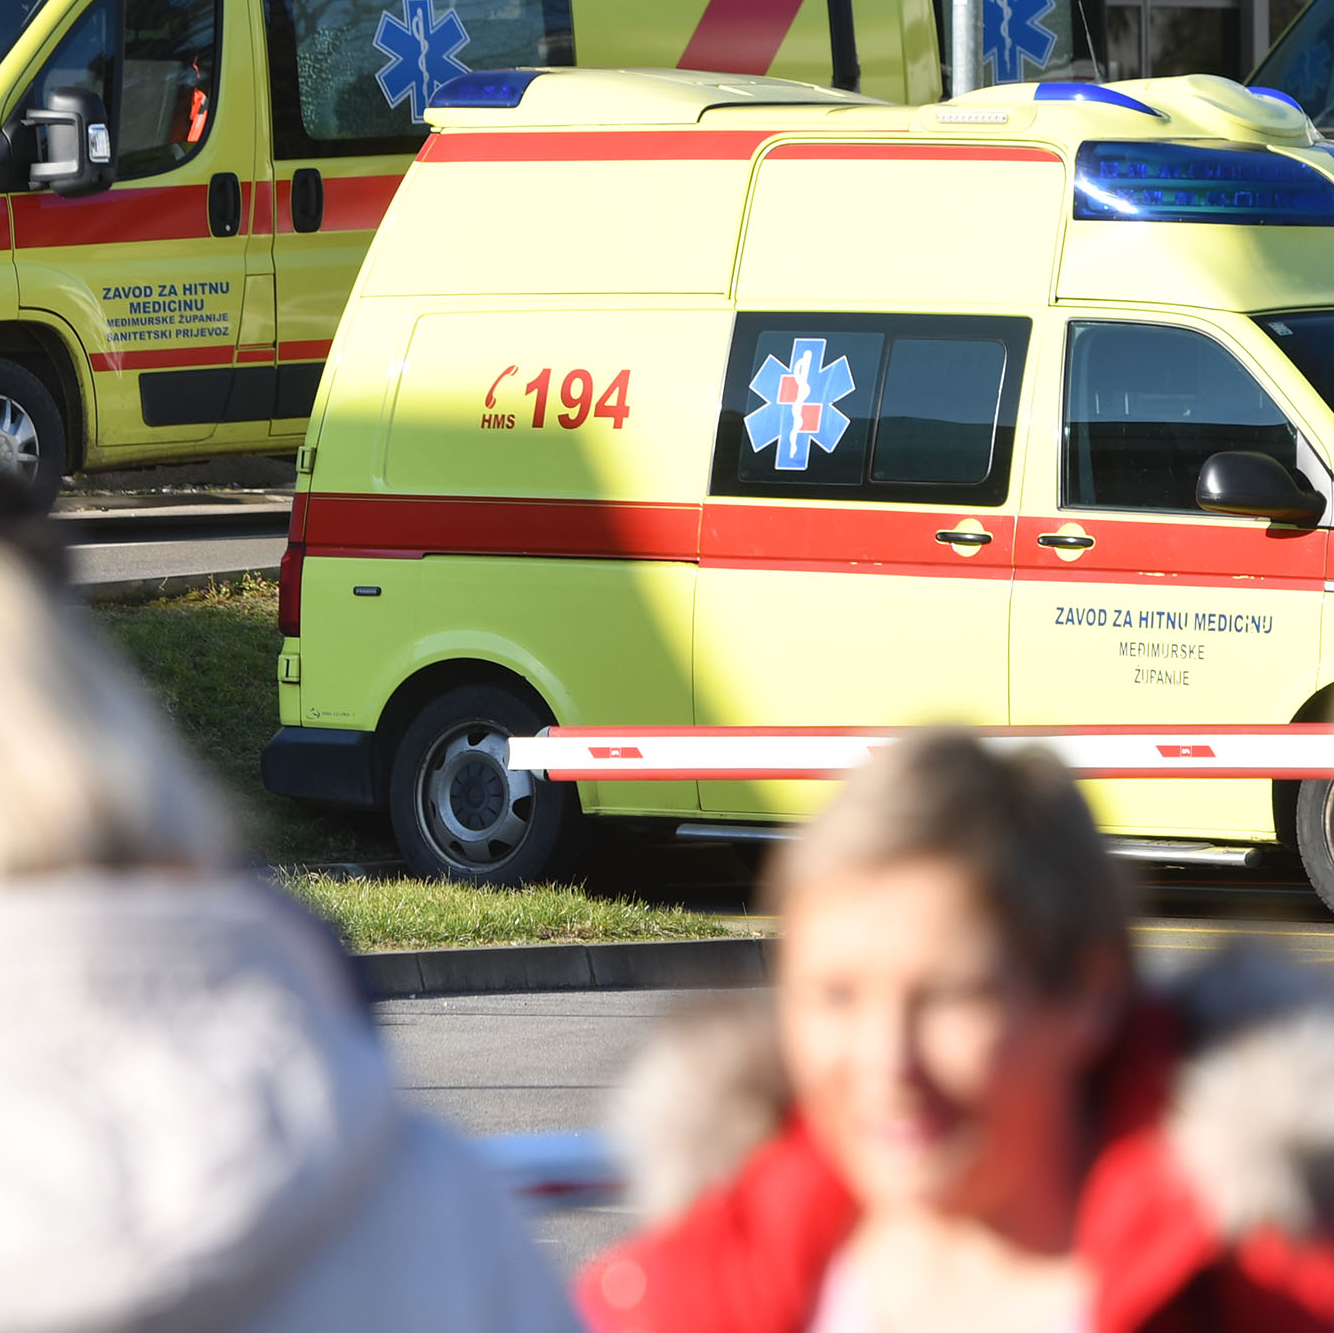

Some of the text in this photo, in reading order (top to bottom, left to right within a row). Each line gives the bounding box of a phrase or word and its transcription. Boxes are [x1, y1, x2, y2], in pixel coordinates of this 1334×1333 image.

[102, 282, 230, 300] ZAVOD ZA HITNU
[129, 299, 205, 314] MEDICINU
[179, 312, 229, 324] ŽUPANIJE
[107, 327, 229, 342] SANITETSKI PRIJEVOZ
[525, 368, 631, 430] 194
[481, 414, 515, 429] HMS
[1055, 607, 1273, 634] ZAVOD ZA HITNU MEDICINU
